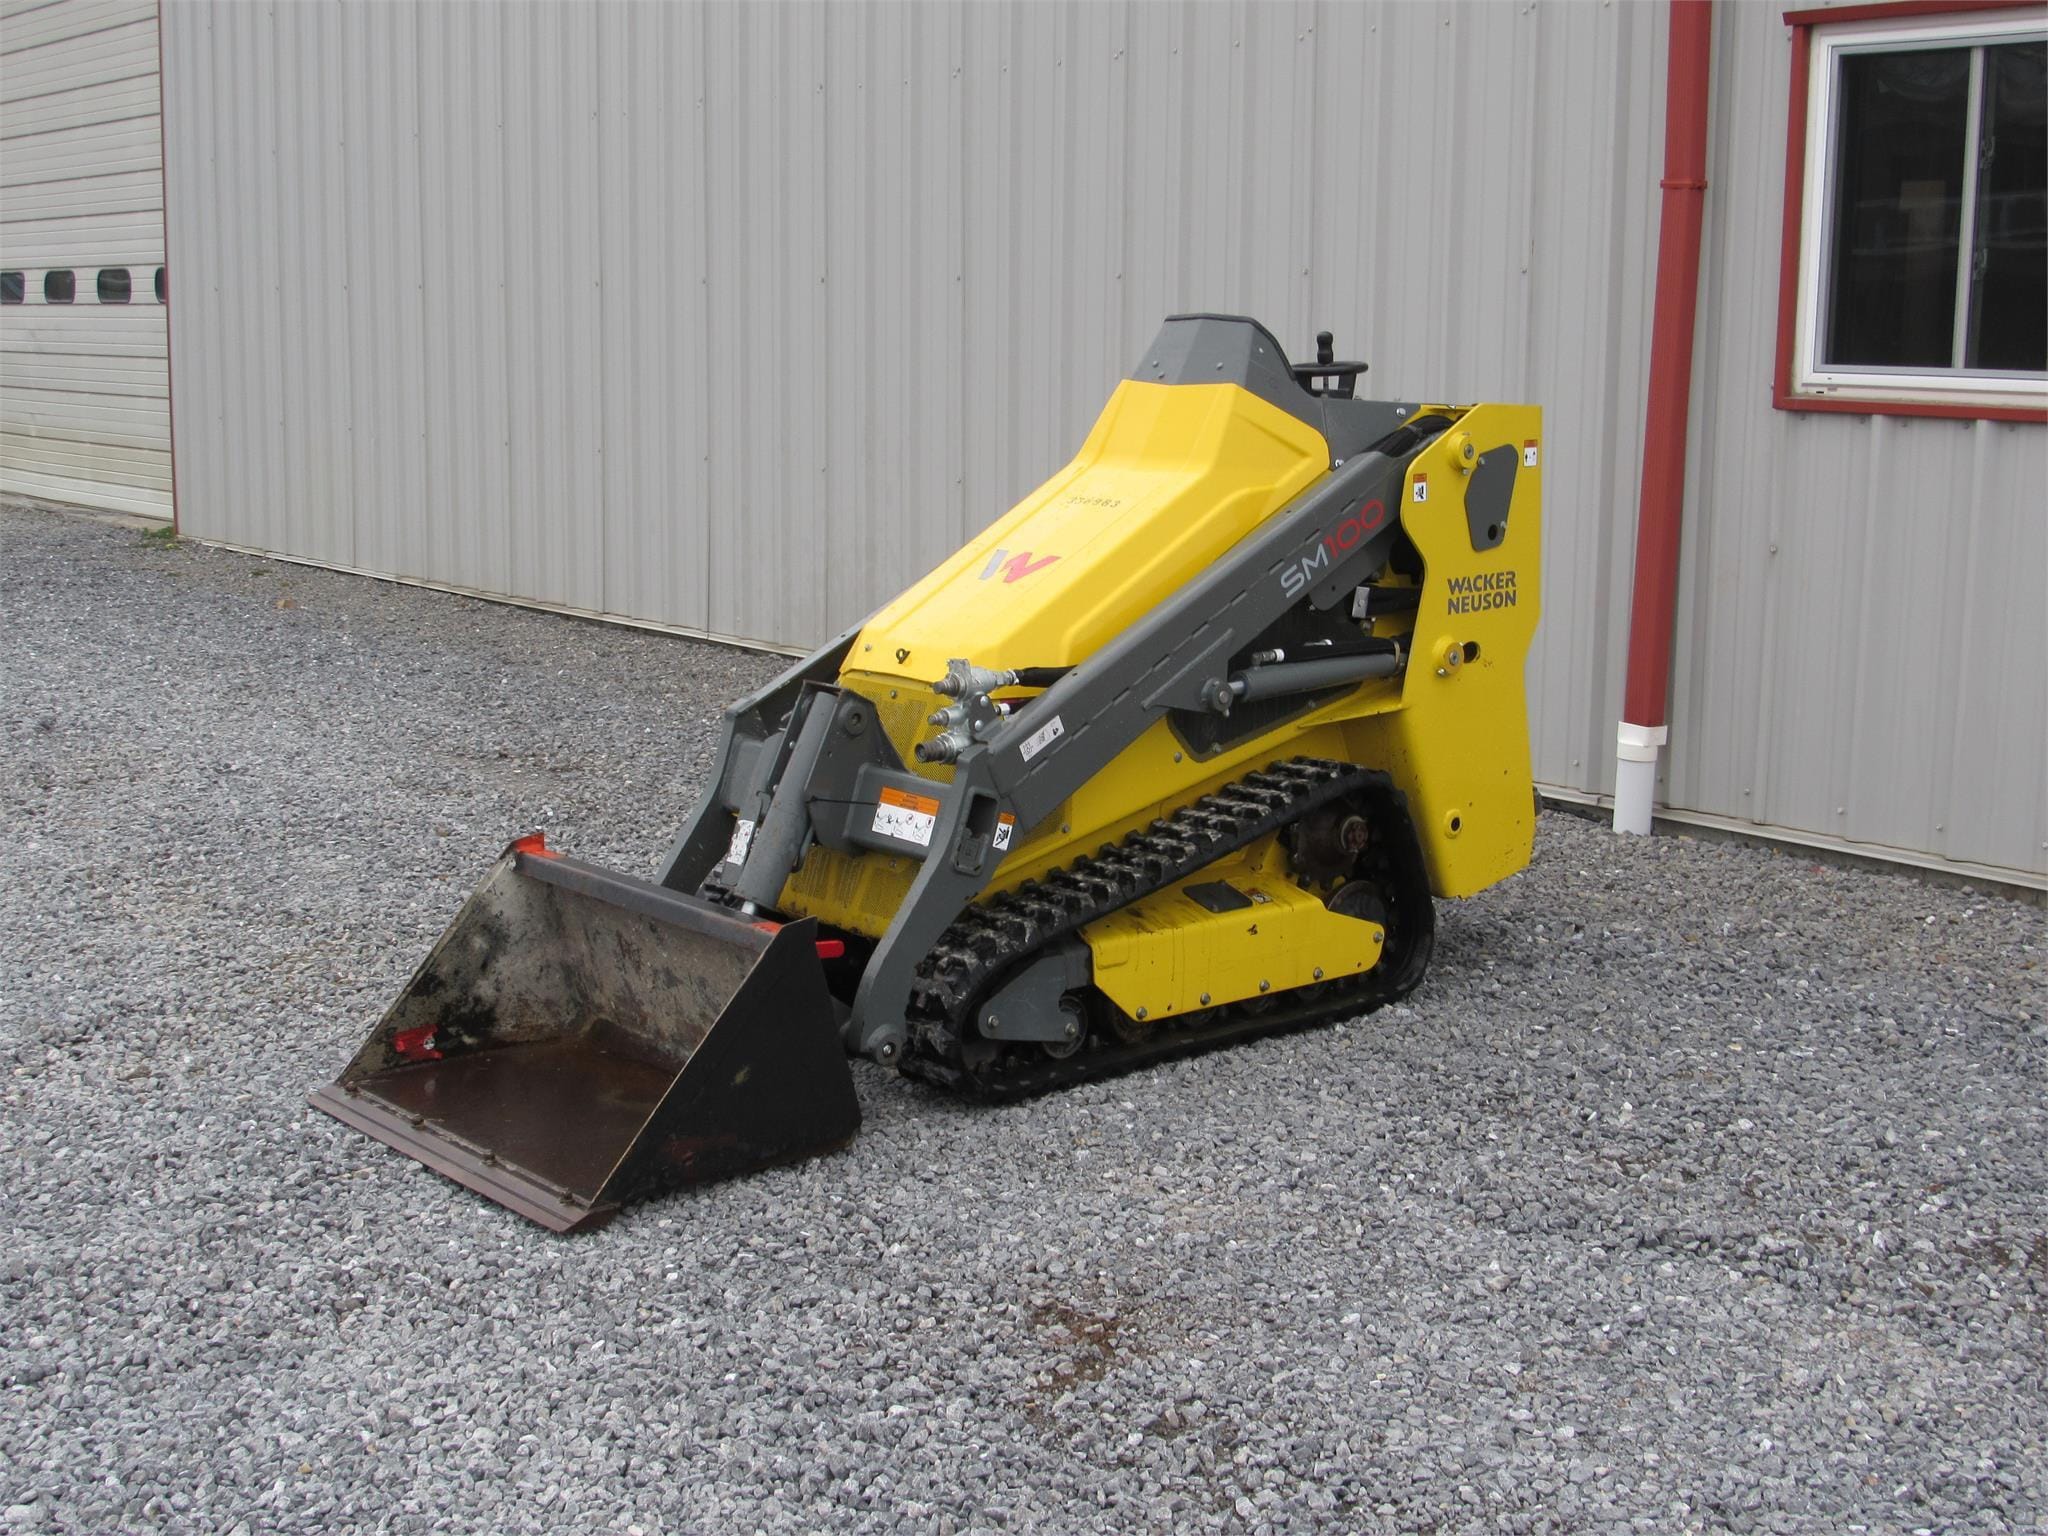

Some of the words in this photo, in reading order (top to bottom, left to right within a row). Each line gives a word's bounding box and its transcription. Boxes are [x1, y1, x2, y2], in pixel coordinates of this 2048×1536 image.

[1281, 499, 1385, 598] SM100
[1447, 570, 1517, 595] WACKER
[1447, 590, 1517, 616] NEUSON
